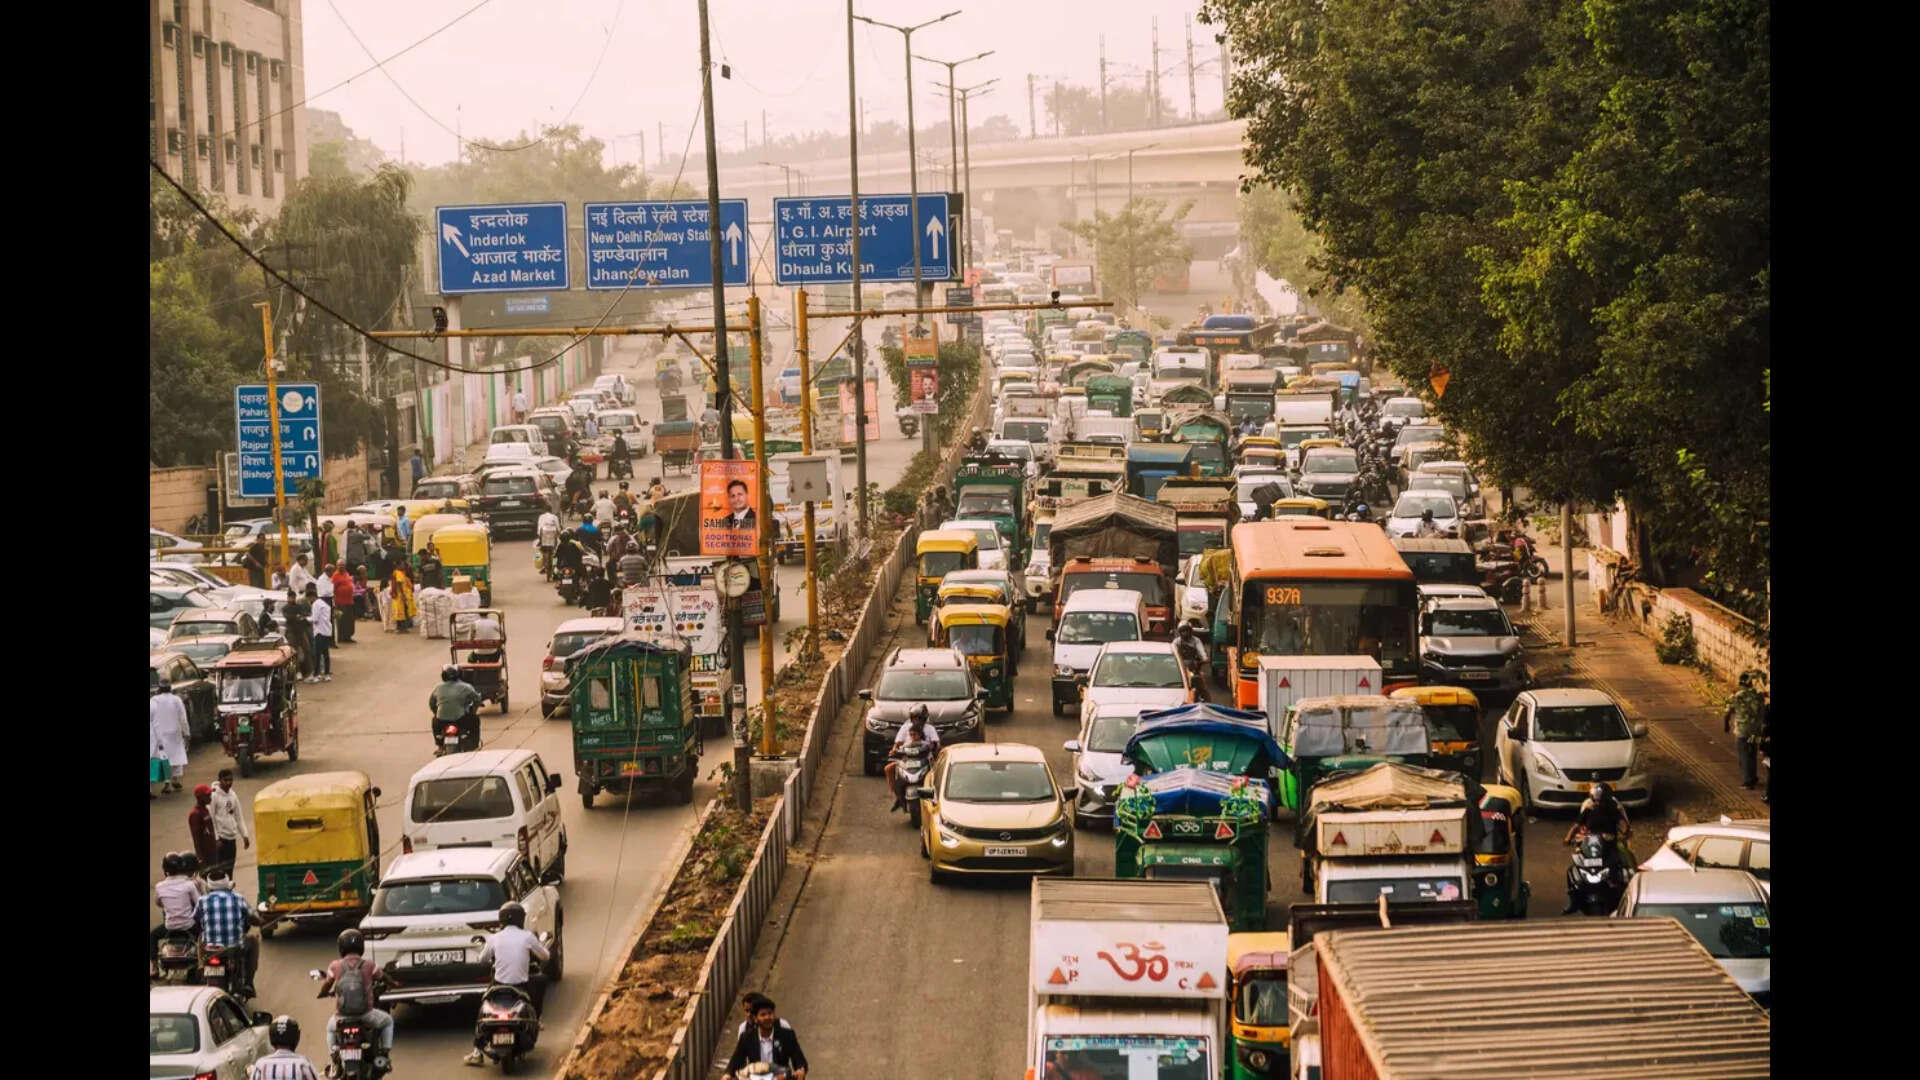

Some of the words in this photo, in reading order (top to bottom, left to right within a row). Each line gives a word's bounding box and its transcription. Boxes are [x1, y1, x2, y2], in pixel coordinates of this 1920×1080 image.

[591, 208, 608, 227] नई
[613, 208, 646, 225] दिल्ली
[652, 208, 678, 224] रेलवे
[683, 208, 711, 223] स्टेश
[818, 206, 834, 218] अ.
[469, 210, 529, 230] इन्द्रलोक
[469, 232, 526, 247] Inderlok
[592, 231, 614, 243] New
[616, 230, 643, 243] Delhi
[645, 230, 684, 245] Railway
[687, 229, 730, 241] Statin
[781, 227, 789, 239] I.
[792, 226, 808, 238] G.
[811, 226, 819, 238] I.
[592, 245, 668, 263] झण्डेवालान
[781, 241, 815, 257] धौला
[471, 251, 517, 265] आजाद
[472, 270, 507, 284] Azad
[511, 269, 556, 283] Market
[782, 263, 832, 276] Dhaula
[241, 440, 268, 451] Rajpur
[1267, 587, 1301, 604] 937A
